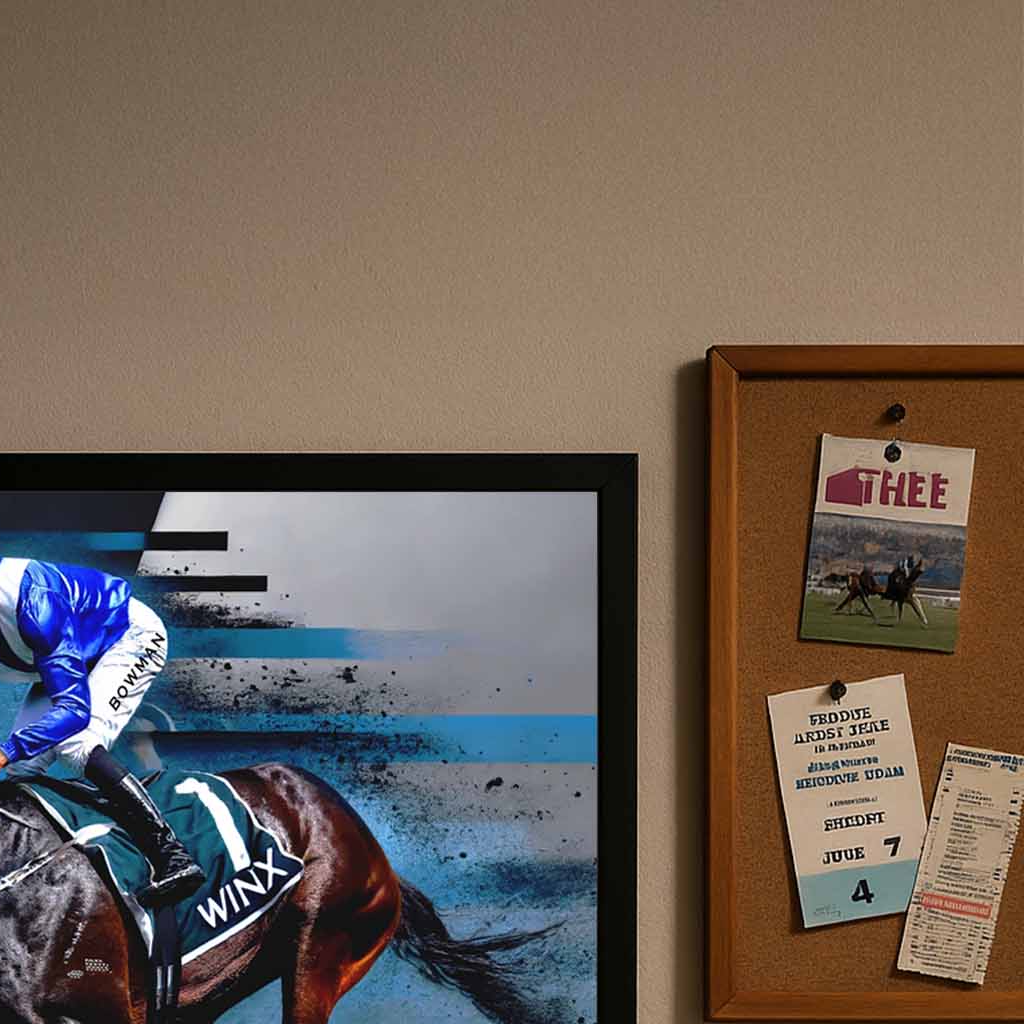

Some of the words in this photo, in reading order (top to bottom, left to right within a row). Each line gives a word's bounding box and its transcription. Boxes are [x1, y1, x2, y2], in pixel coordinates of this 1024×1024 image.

[108, 632, 166, 712] BOWMAN
[175, 777, 251, 873] 1
[883, 836, 901, 857] 7
[197, 848, 288, 928] WINX
[851, 879, 875, 904] 4
